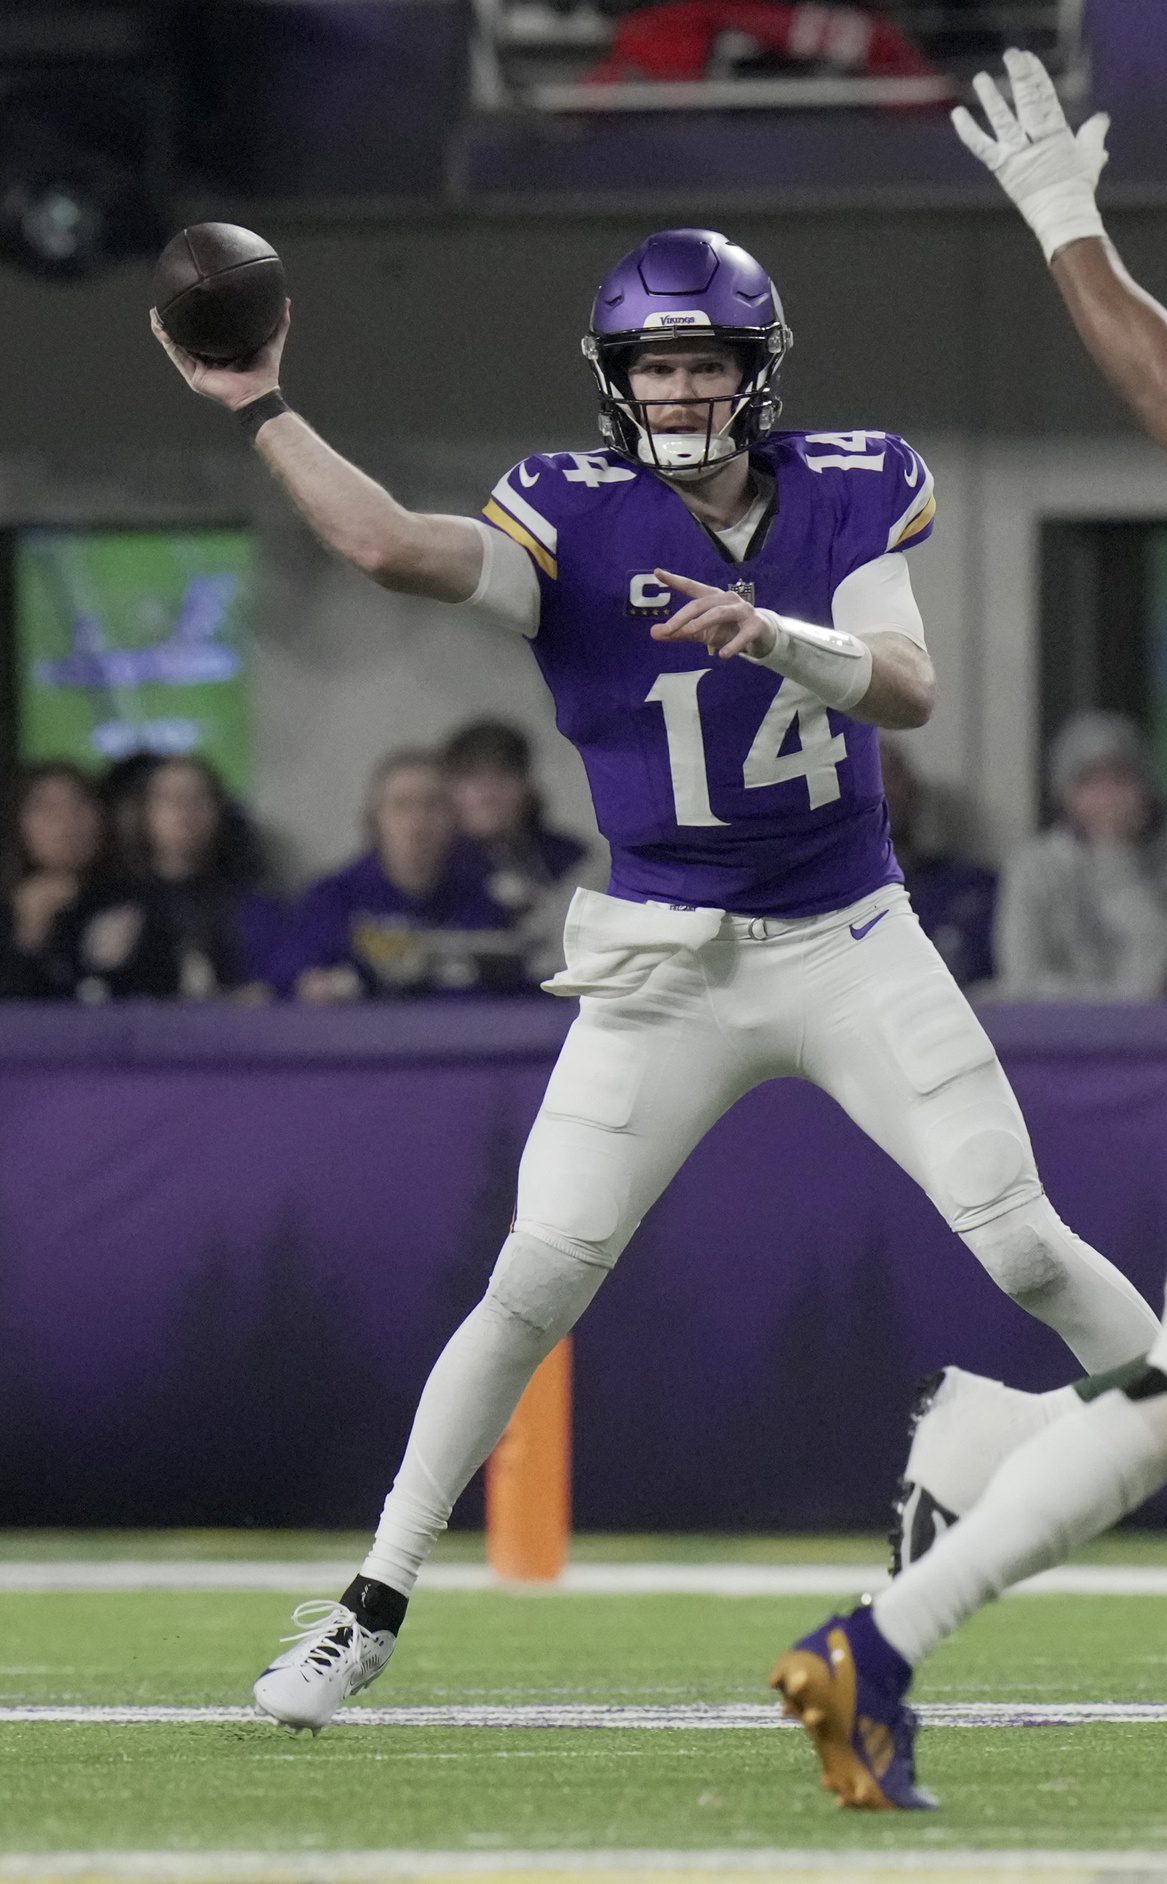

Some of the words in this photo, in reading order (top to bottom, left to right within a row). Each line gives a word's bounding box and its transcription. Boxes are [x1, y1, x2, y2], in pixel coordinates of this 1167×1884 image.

[805, 430, 887, 474] 14
[629, 573, 671, 608] C
[644, 668, 848, 827] 14
